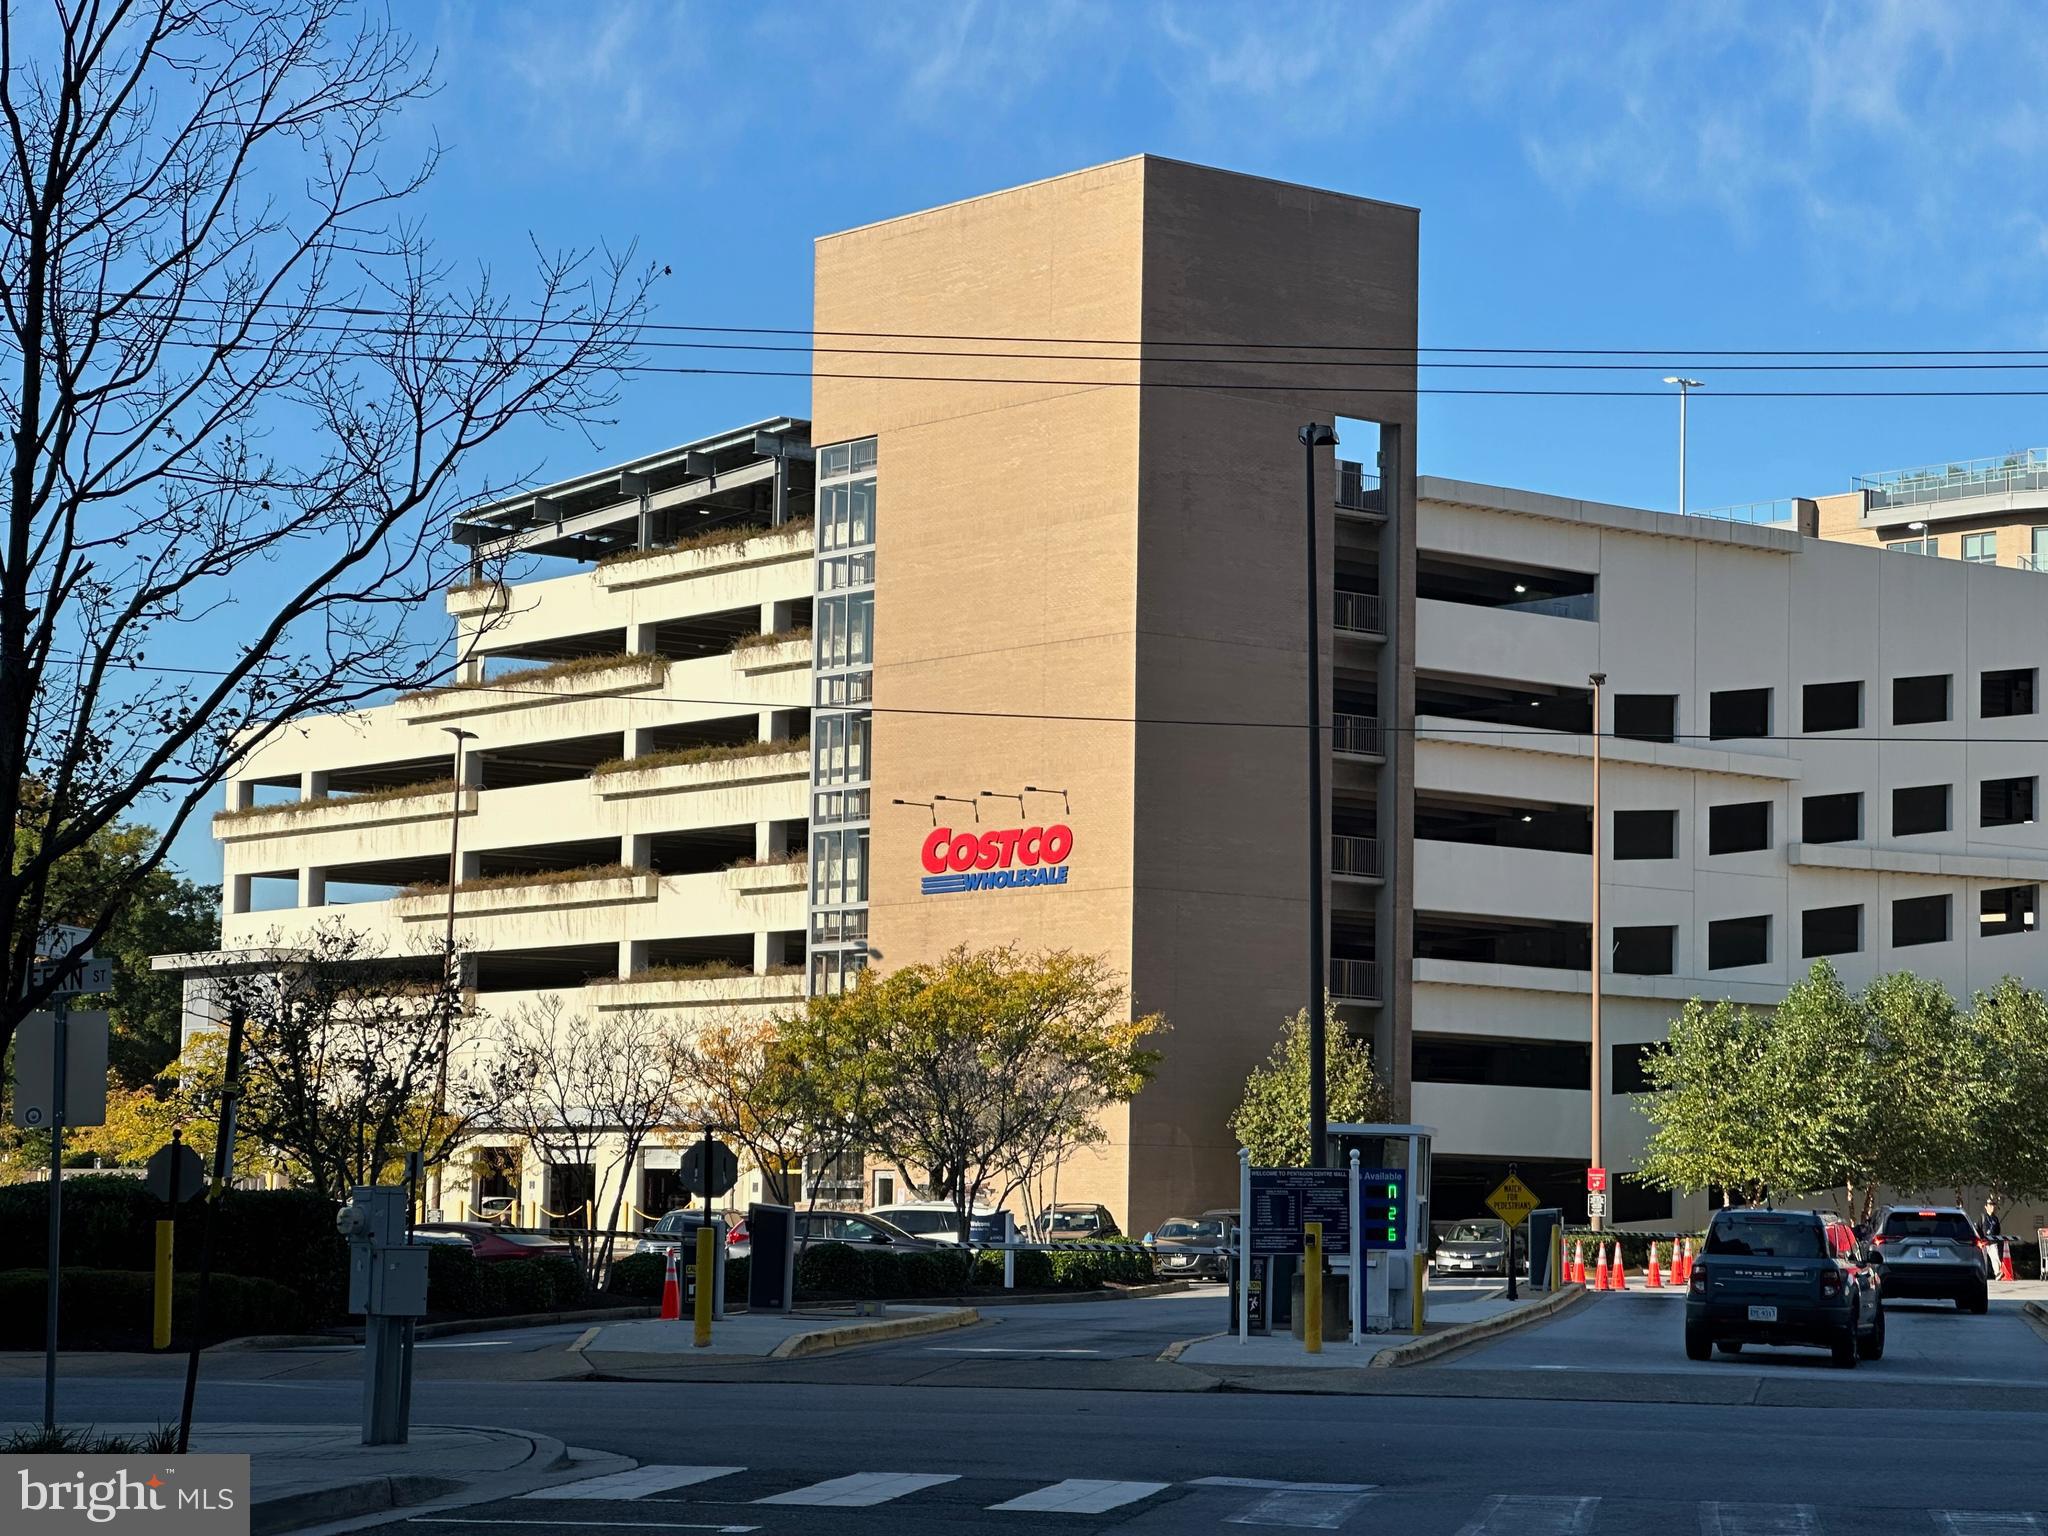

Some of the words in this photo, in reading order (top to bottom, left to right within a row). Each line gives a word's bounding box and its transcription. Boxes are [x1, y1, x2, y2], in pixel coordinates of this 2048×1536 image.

[922, 824, 1073, 874] COSTCO
[963, 866, 1069, 891] WHOLESALE
[59, 931, 76, 954] ST
[93, 969, 106, 983] ST
[1364, 1172, 1402, 1180] Available
[1504, 1184, 1521, 1192] WATCH
[1494, 1201, 1531, 1209] PEDESTRIANS
[1388, 1207, 1397, 1220] 2
[1388, 1228, 1396, 1241] 6
